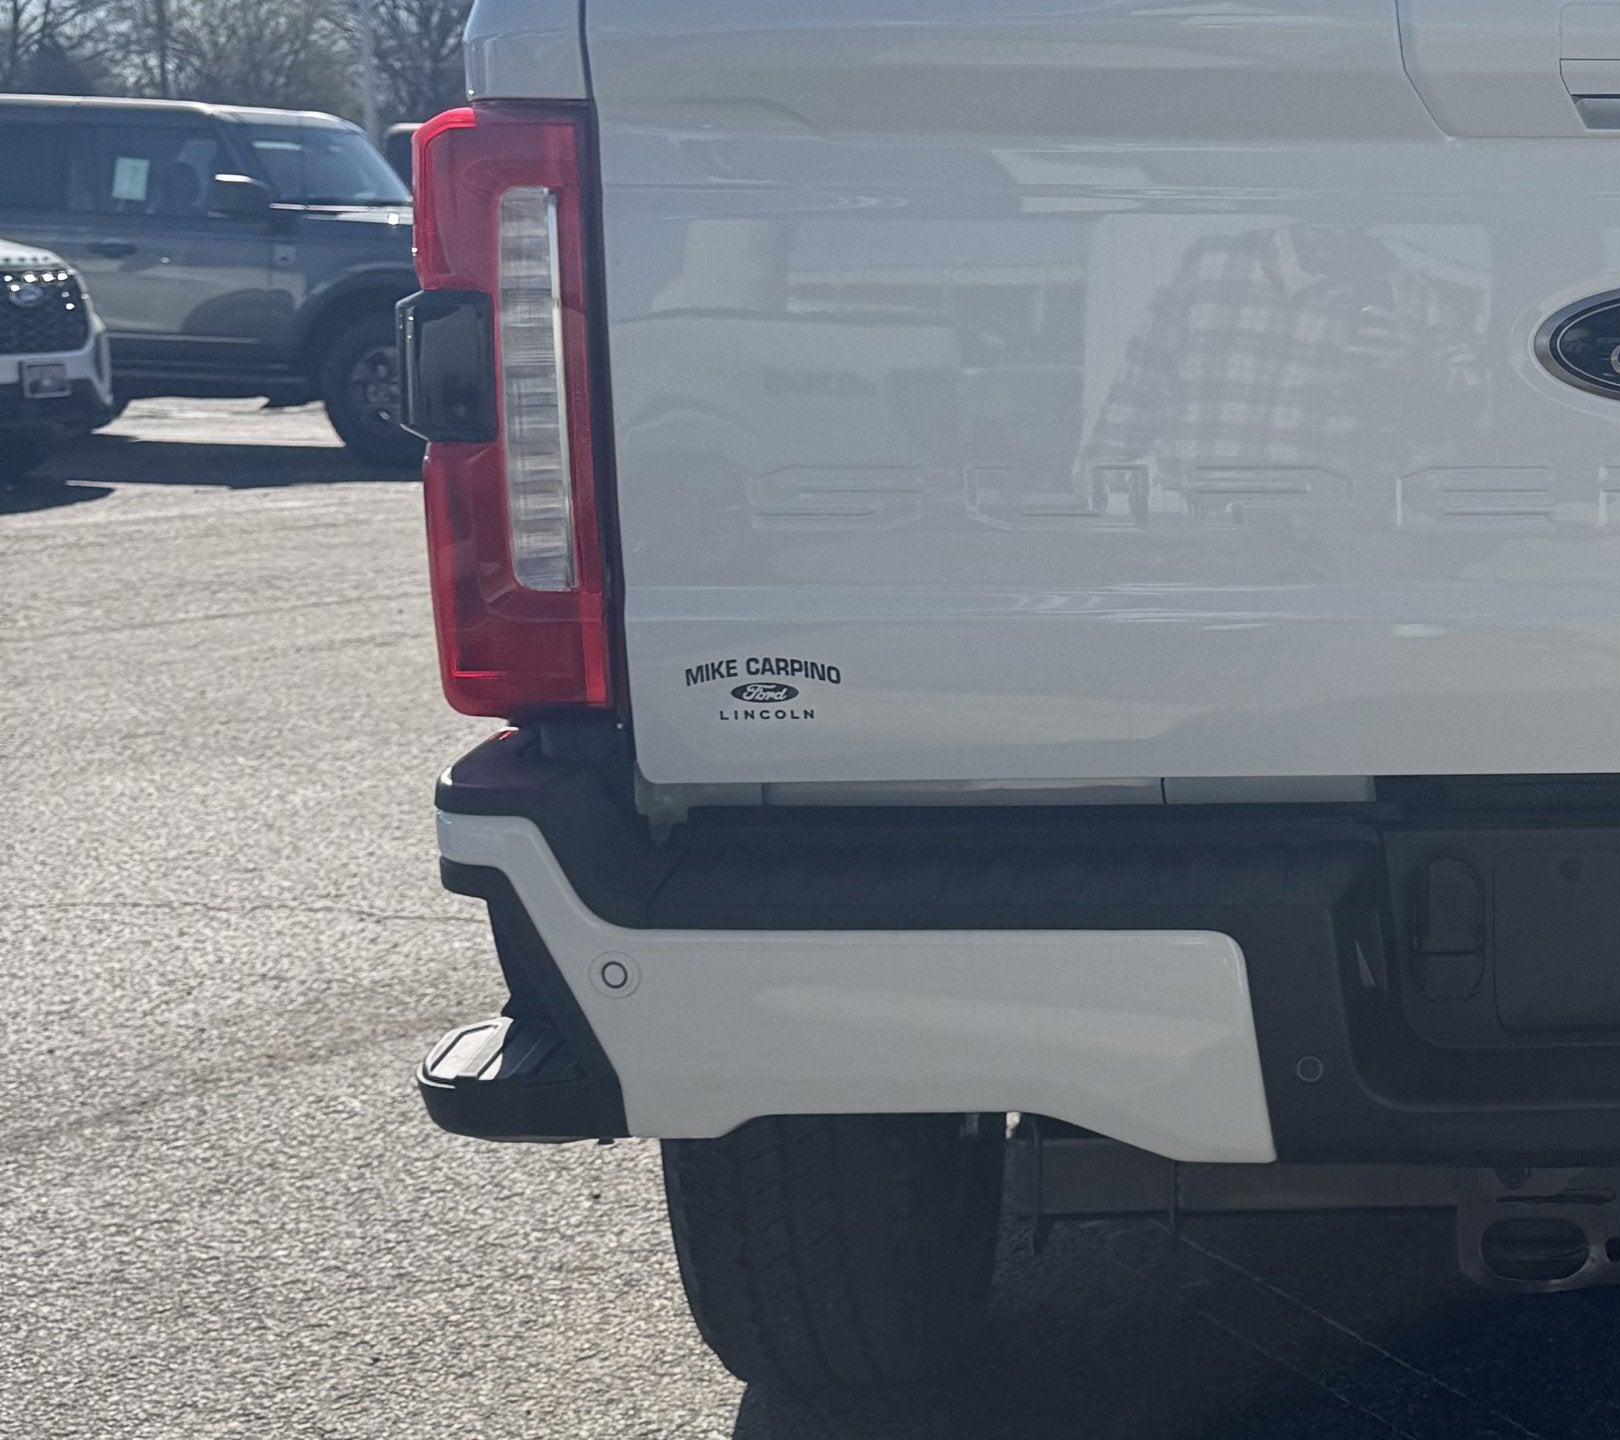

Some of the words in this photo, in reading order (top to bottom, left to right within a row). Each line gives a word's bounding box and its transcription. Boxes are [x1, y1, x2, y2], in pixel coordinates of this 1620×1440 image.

[685, 659, 738, 687] MIKE
[746, 657, 841, 685] CARPINO
[741, 684, 788, 701] Ford
[719, 709, 816, 720] LINCOLN
